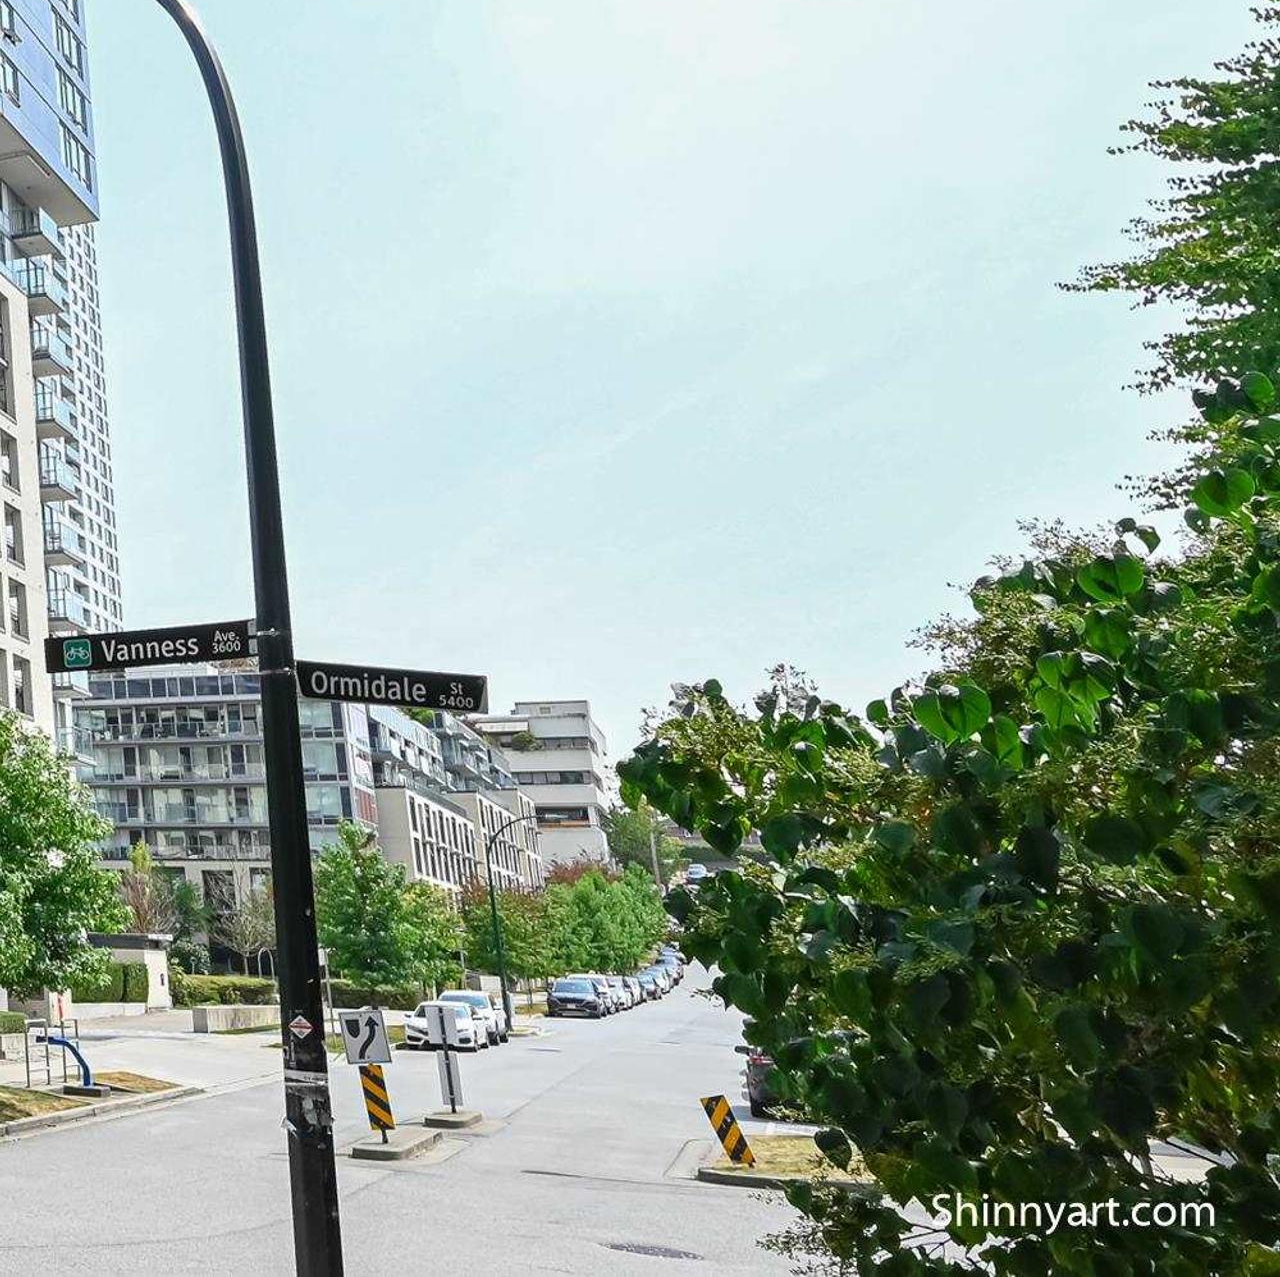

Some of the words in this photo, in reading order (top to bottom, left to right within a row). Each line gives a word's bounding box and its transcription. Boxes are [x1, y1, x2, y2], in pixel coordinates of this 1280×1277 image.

[213, 630, 240, 642] Ave.
[100, 638, 200, 662] Vanness
[211, 640, 241, 654] 3600
[310, 670, 427, 703] Ormidale
[450, 681, 464, 695] St
[439, 694, 474, 709] 5400
